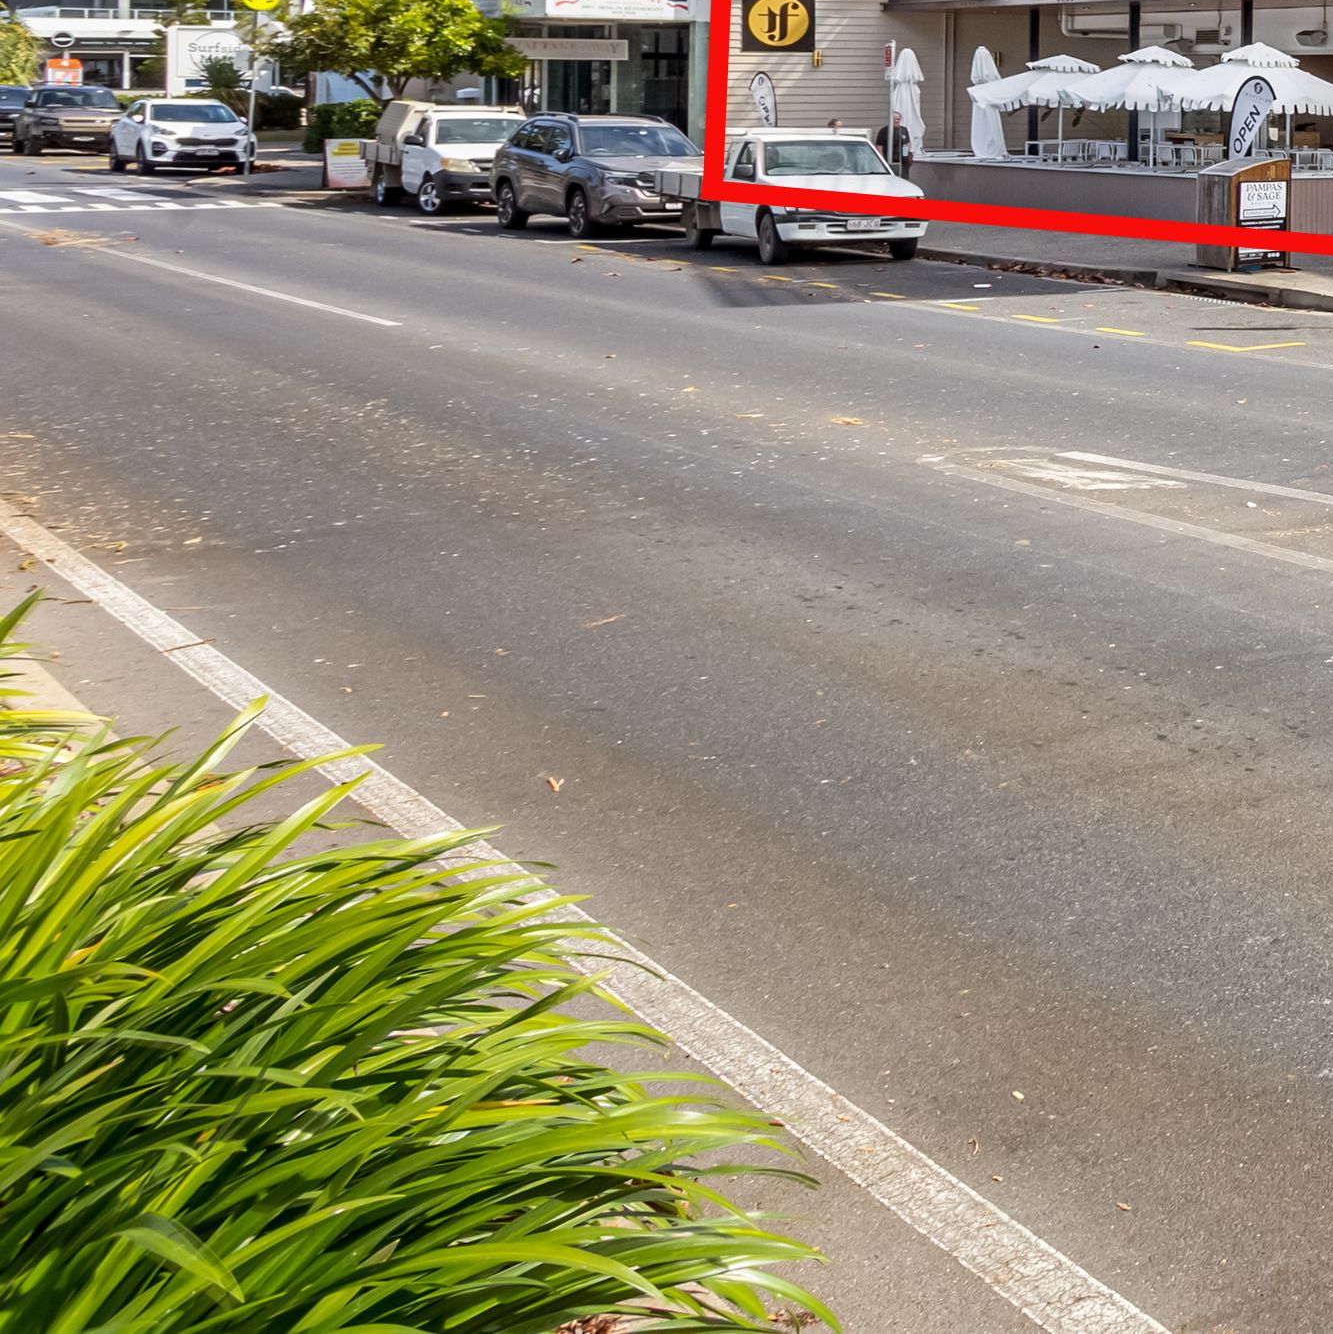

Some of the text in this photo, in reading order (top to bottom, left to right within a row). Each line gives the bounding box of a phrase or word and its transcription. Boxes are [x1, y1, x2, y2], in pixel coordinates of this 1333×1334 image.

[188, 42, 240, 54] Surfsid
[1233, 104, 1260, 154] OPEN
[1246, 183, 1282, 192] PAMPAS
[1247, 192, 1280, 201] & SAGE
